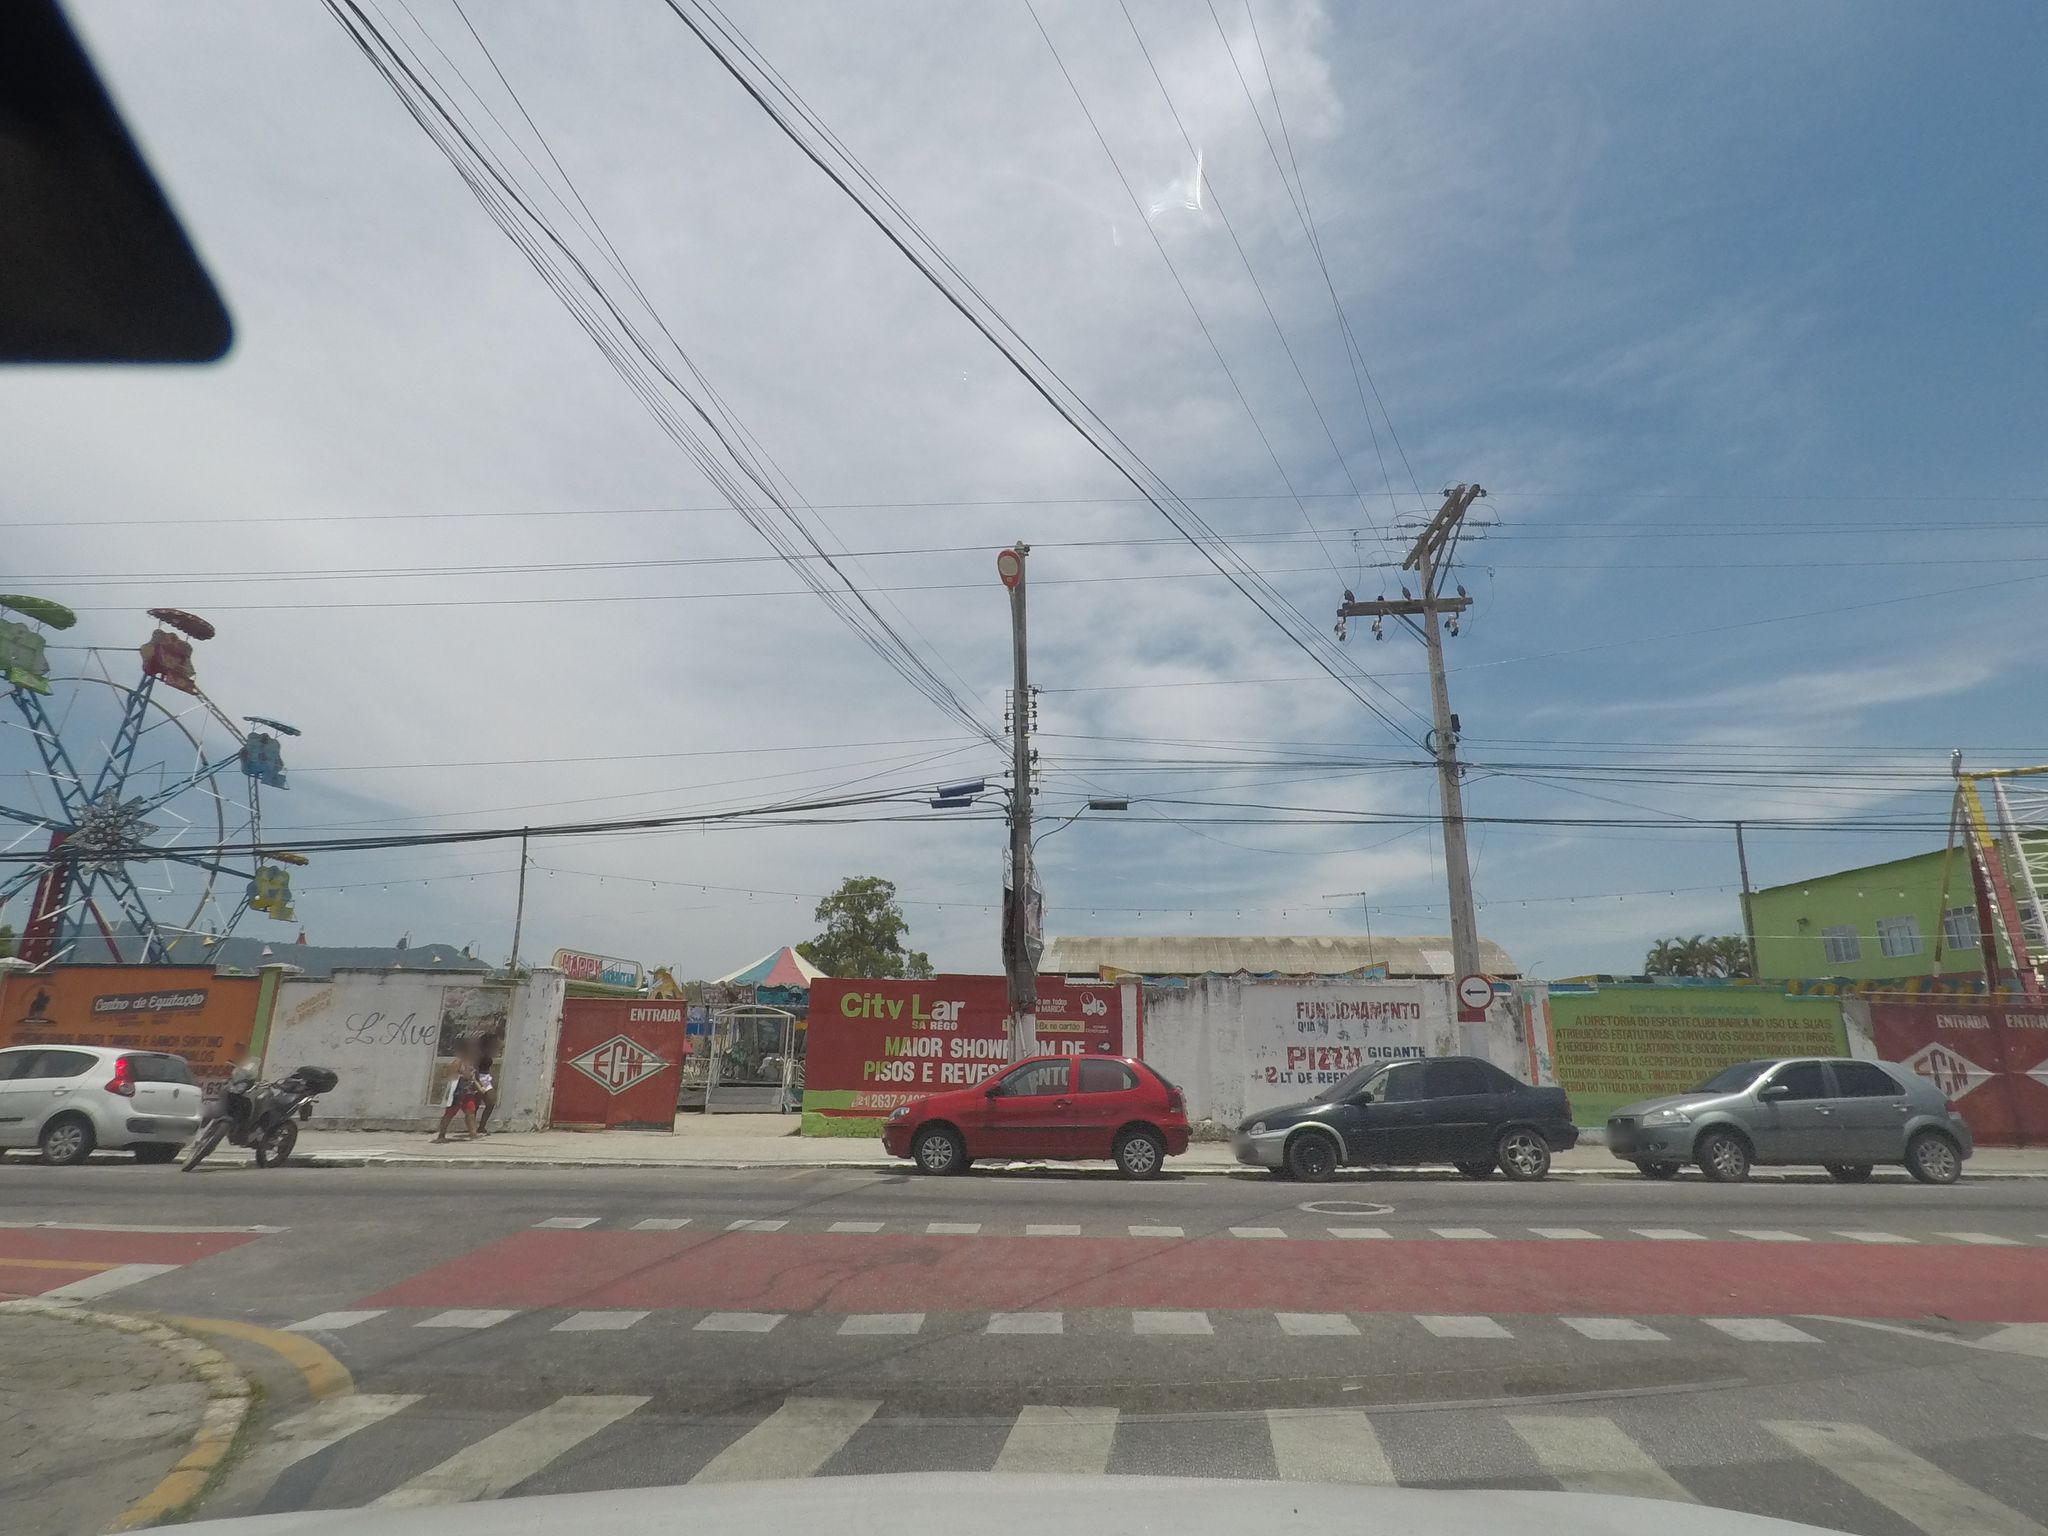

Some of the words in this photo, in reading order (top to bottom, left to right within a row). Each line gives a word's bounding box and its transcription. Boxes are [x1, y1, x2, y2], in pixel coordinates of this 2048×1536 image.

[95, 999, 129, 1011] Centro
[132, 998, 147, 1009] de
[148, 993, 205, 1011] Equitação
[912, 994, 965, 1021] Lar
[1296, 1001, 1421, 1020] FUNCIONAMENTO
[630, 1008, 682, 1022] ENTRADA
[1575, 1016, 1583, 1026] A
[1584, 1016, 1637, 1027] DIRETORIA
[1638, 1017, 1650, 1027] DO
[1651, 1017, 1691, 1027] ESPORTE
[1766, 1018, 1785, 1029] USO
[1803, 1018, 1833, 1029] SUAS
[1935, 1014, 1991, 1029] ENTRADA
[885, 1036, 943, 1058] MAIOR
[950, 1038, 1056, 1060] SHOWM
[1061, 1040, 1085, 1057] DE
[593, 1041, 644, 1088] ECM
[1287, 1046, 1362, 1071] PIZZA
[1367, 1046, 1425, 1058] GIGANTE
[863, 1061, 915, 1083] PISOS
[921, 1063, 934, 1083] E
[940, 1062, 1071, 1087] REVESNTO
[1265, 1066, 1278, 1084] 2
[1280, 1072, 1293, 1084] LT
[1297, 1072, 1313, 1084] DE
[872, 1093, 927, 1108] 2637-24
